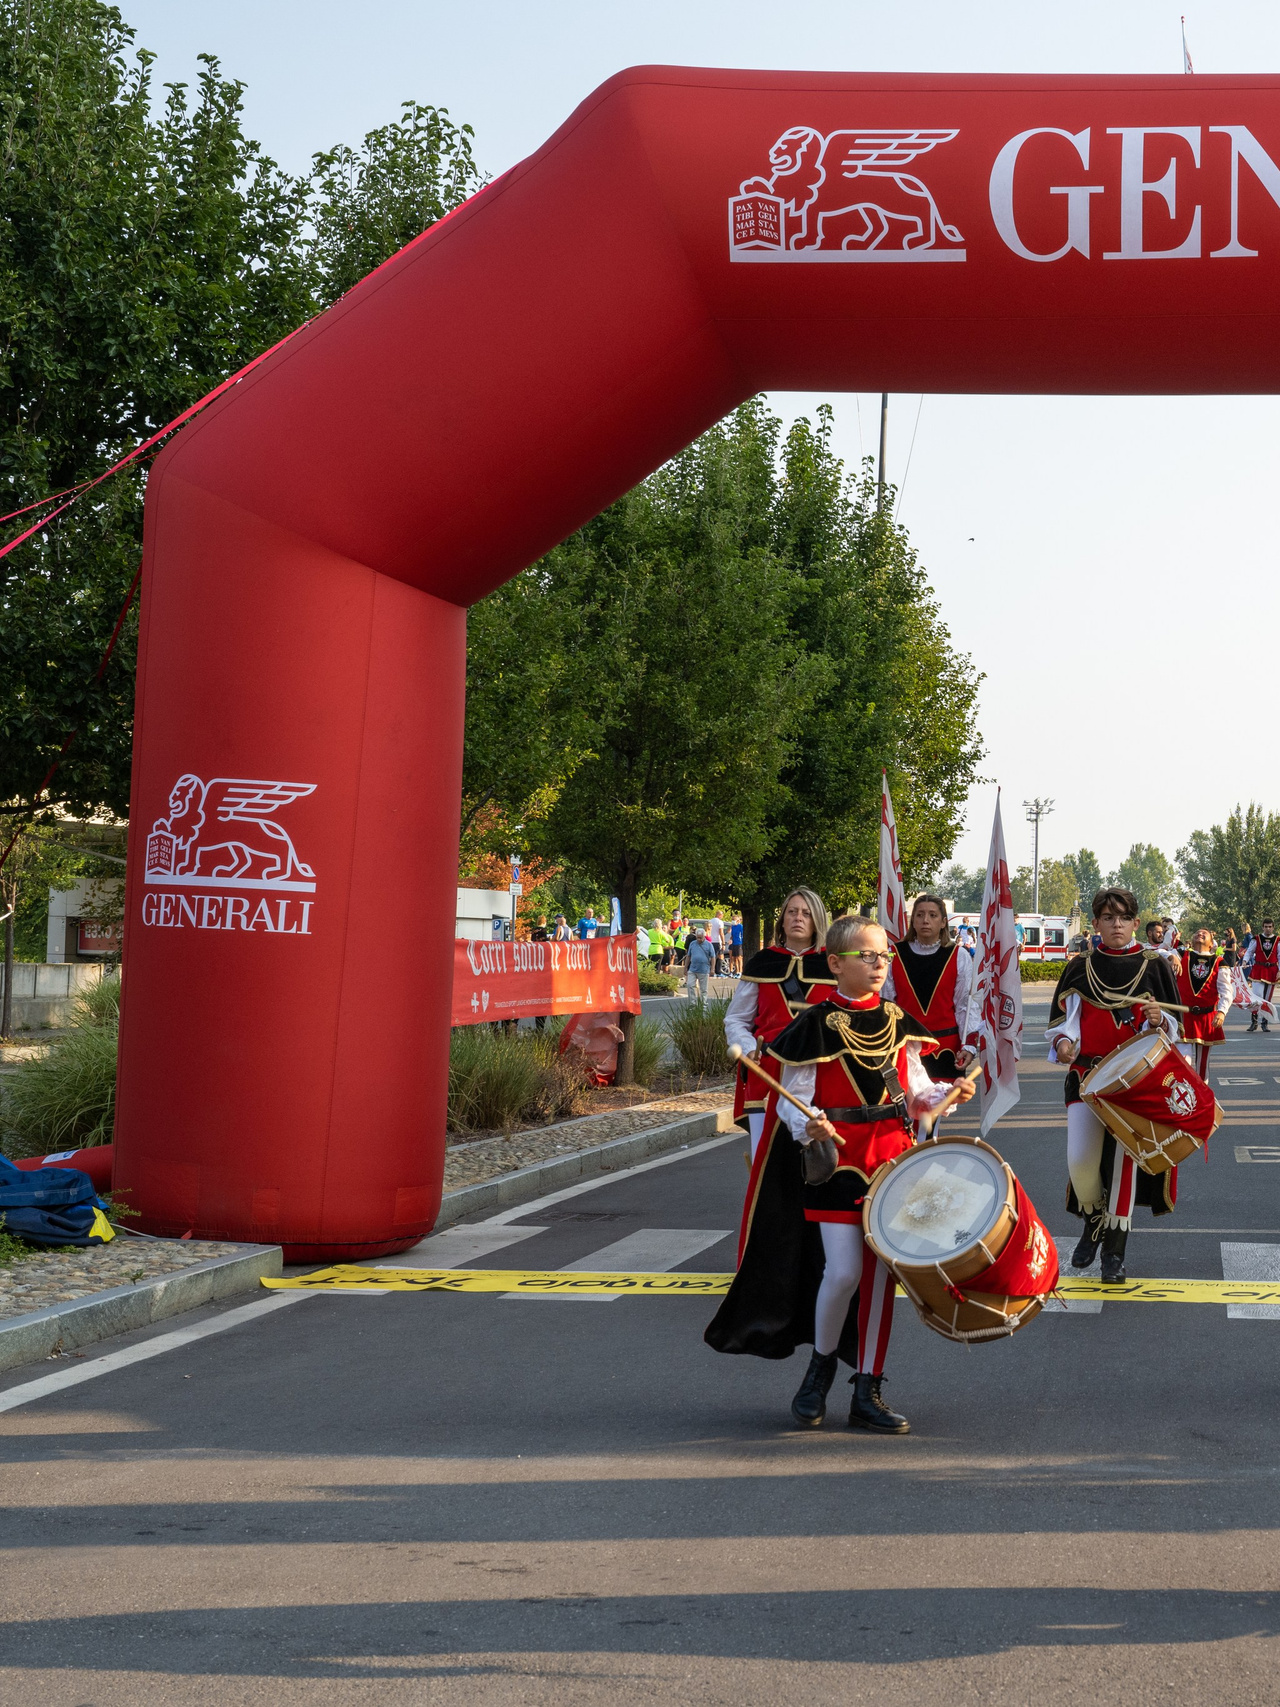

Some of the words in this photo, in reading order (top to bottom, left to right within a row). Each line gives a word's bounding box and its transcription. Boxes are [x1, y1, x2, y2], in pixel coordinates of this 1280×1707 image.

[736, 203, 753, 213] PAX
[758, 202, 775, 213] VAN
[736, 211, 754, 221] TIBI
[758, 210, 777, 222] GELI
[736, 220, 755, 231] MAR
[758, 220, 774, 230] STA
[142, 893, 315, 935] GENERALI
